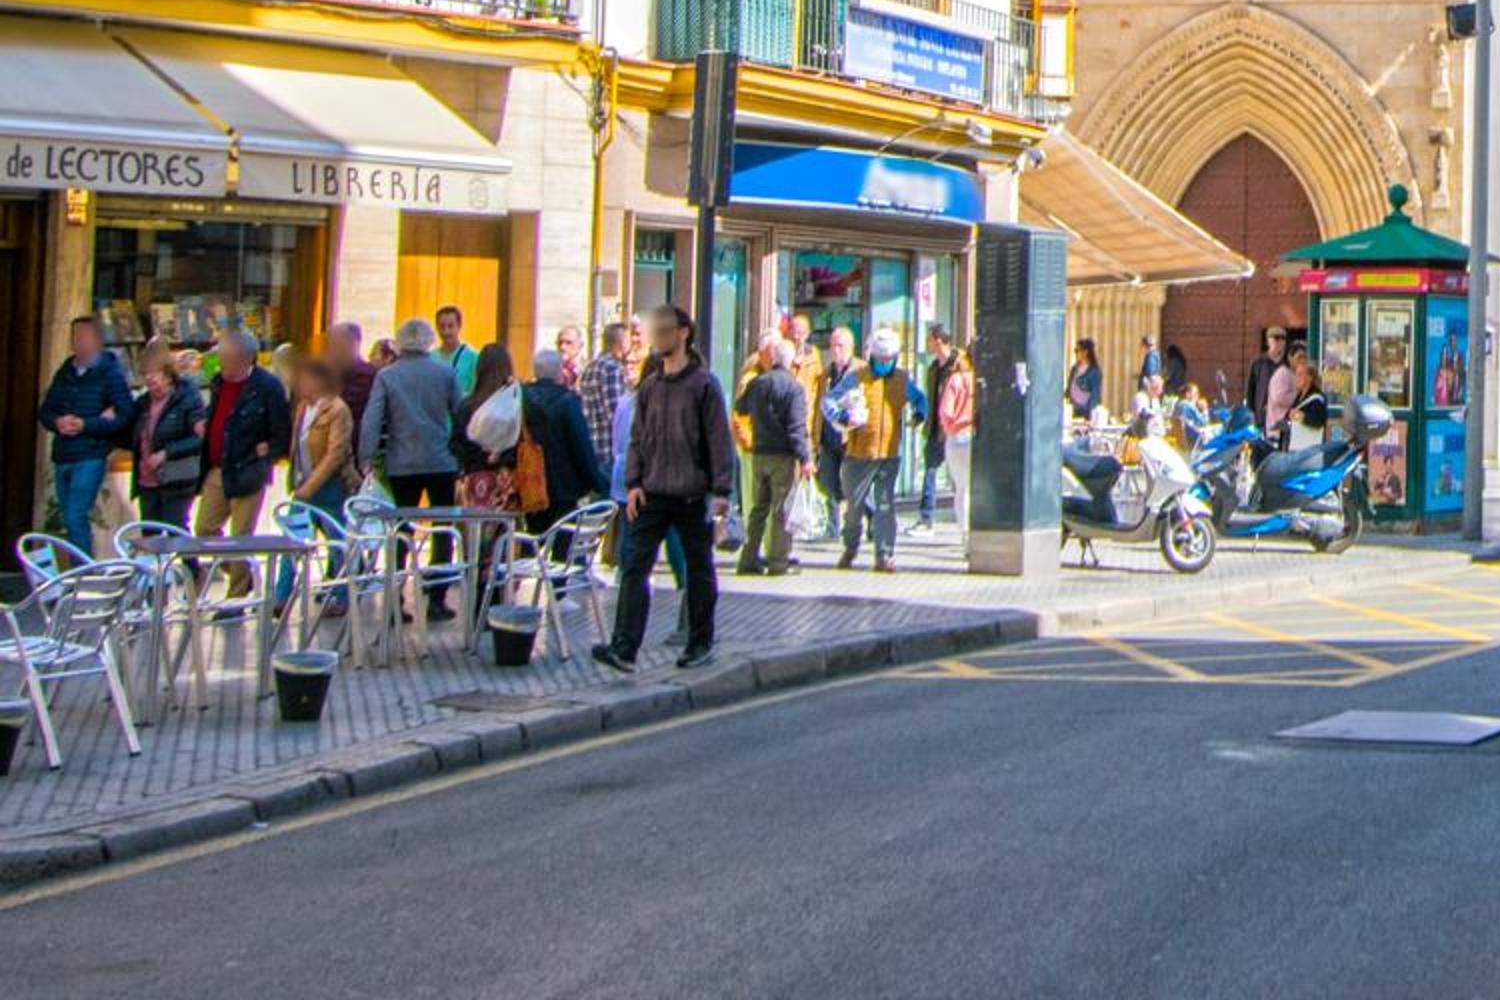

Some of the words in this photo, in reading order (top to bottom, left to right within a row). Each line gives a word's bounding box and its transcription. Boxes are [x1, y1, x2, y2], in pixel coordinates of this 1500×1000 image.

[7, 143, 33, 178] de
[46, 146, 204, 187] LECTORES
[292, 162, 441, 203] LIBRERÍA
